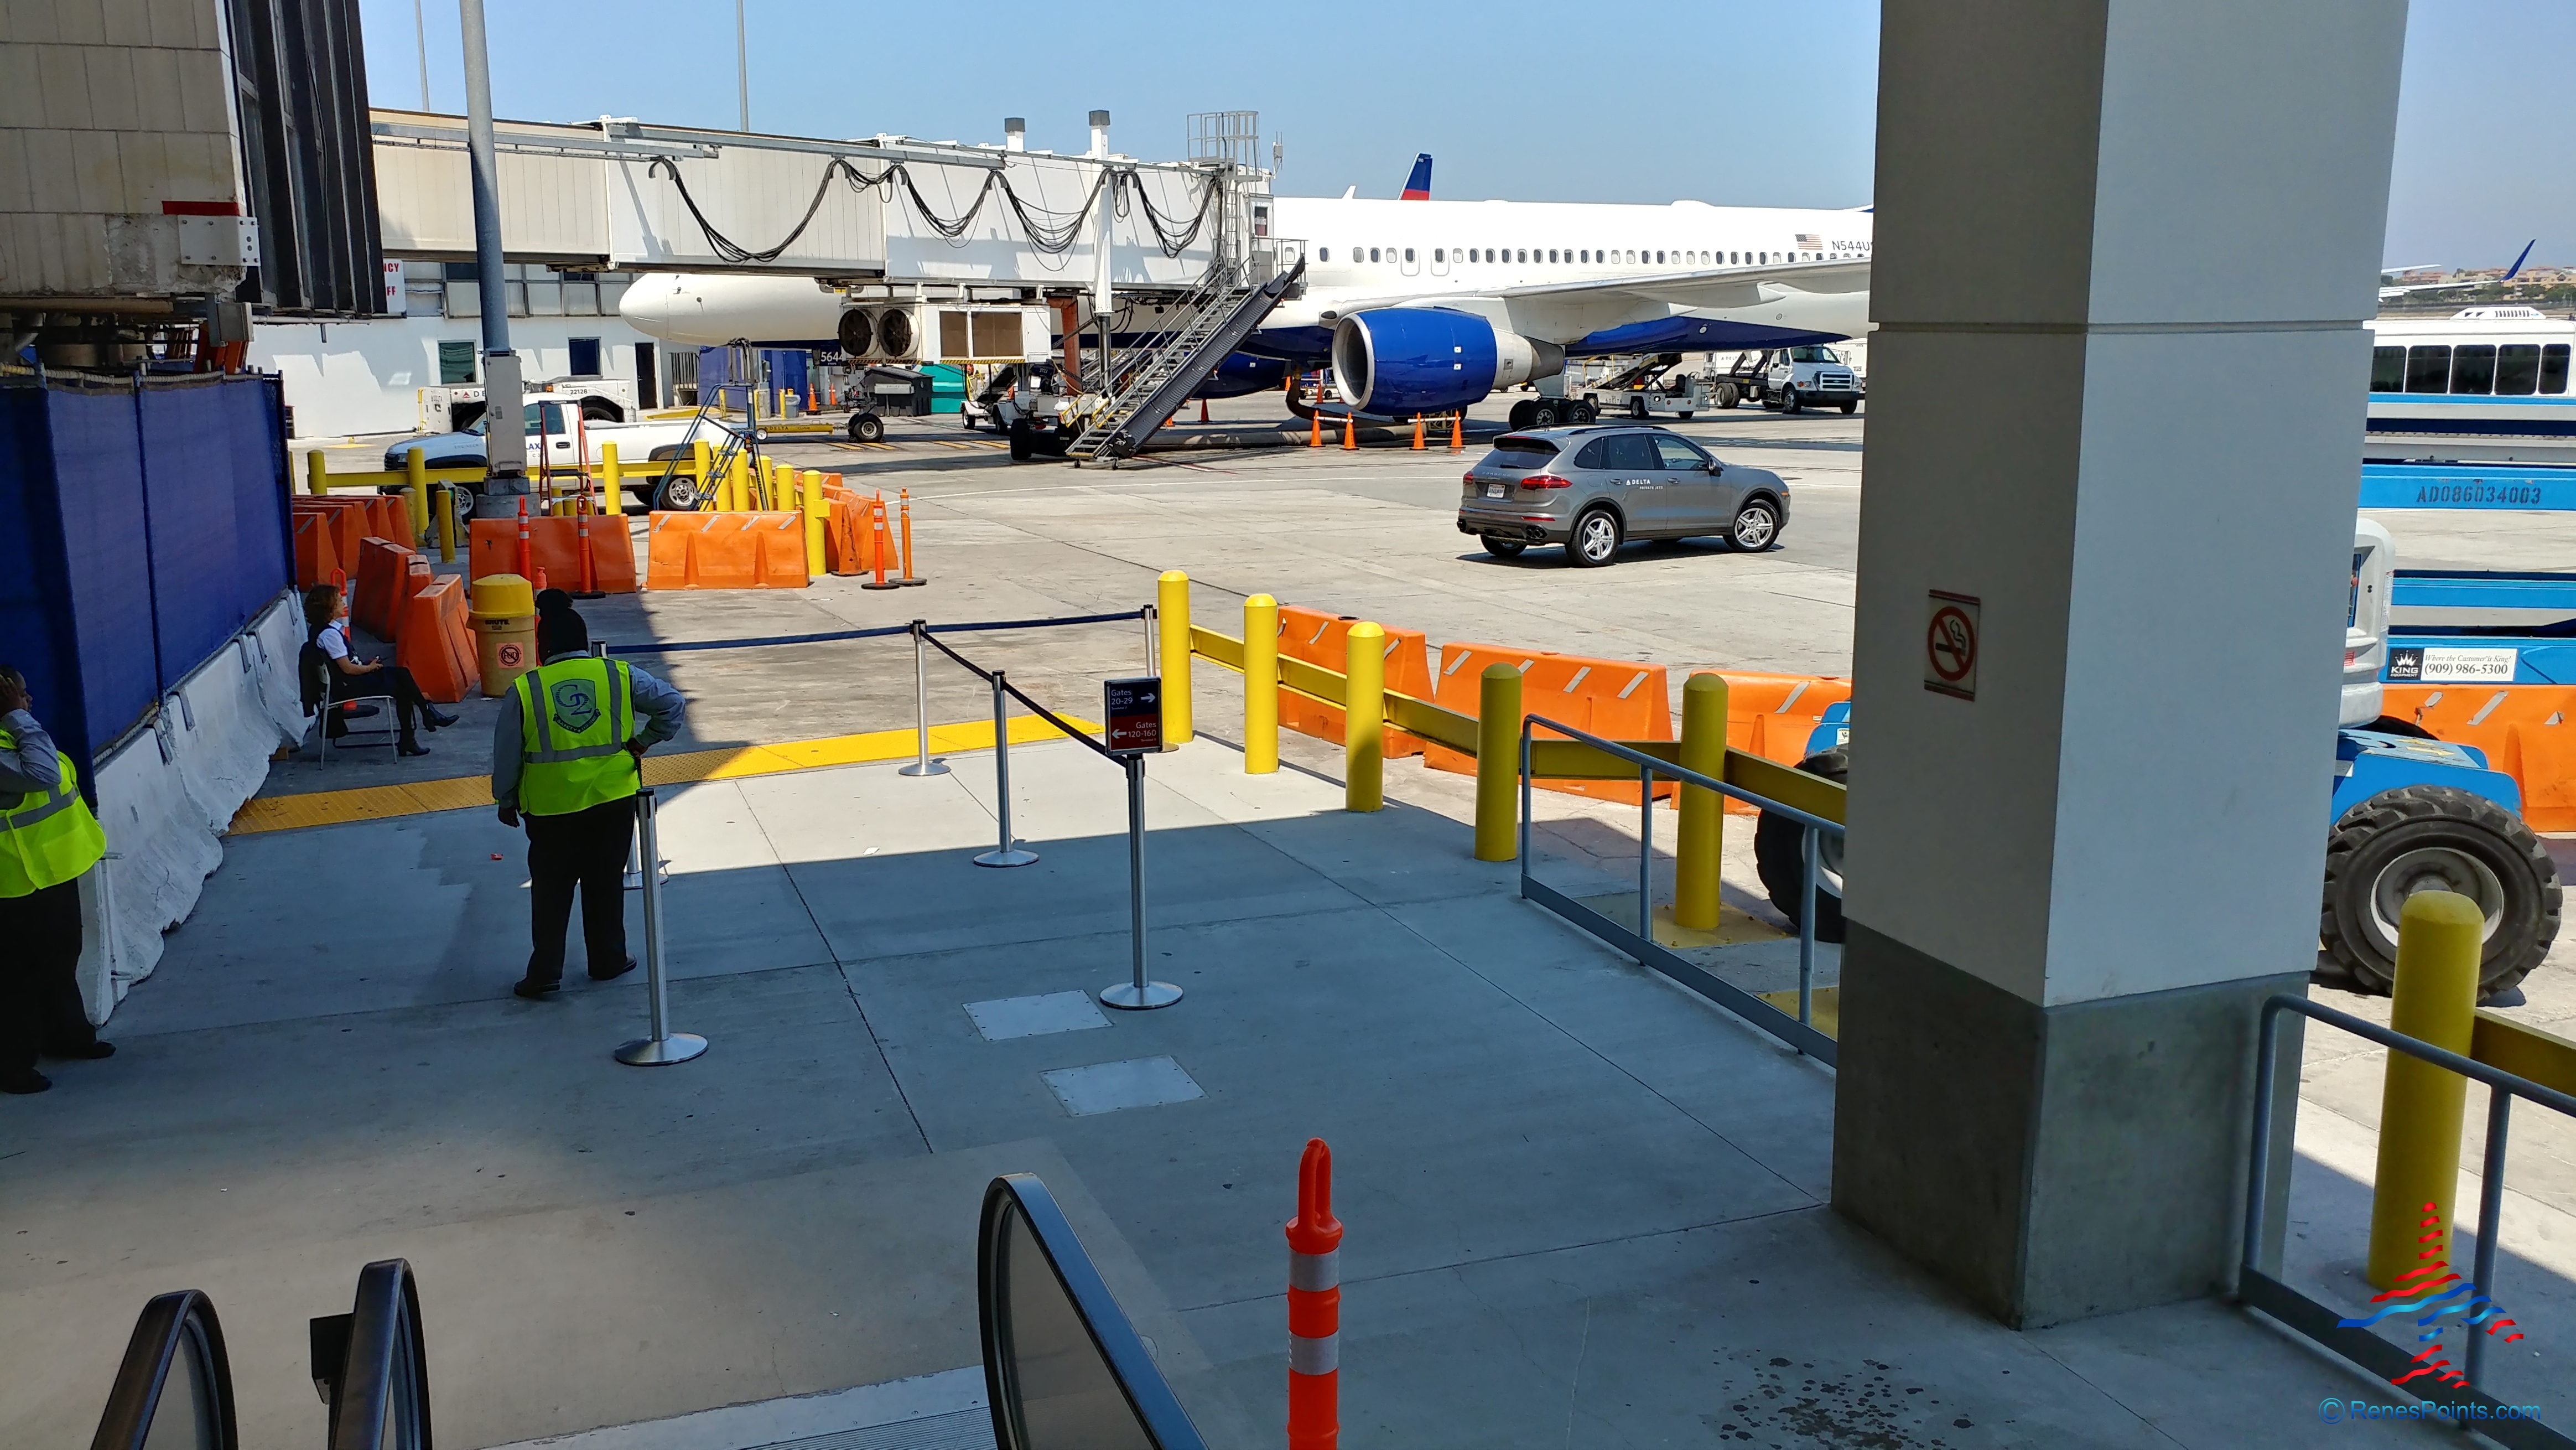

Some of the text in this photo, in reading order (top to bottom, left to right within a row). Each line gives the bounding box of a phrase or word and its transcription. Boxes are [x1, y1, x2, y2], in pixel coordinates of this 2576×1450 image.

[1832, 240, 1873, 251] N544U
[2494, 655, 2511, 664] King!
[2424, 663, 2508, 675] (909) 986-5300
[1128, 729, 1157, 738] 120-160
